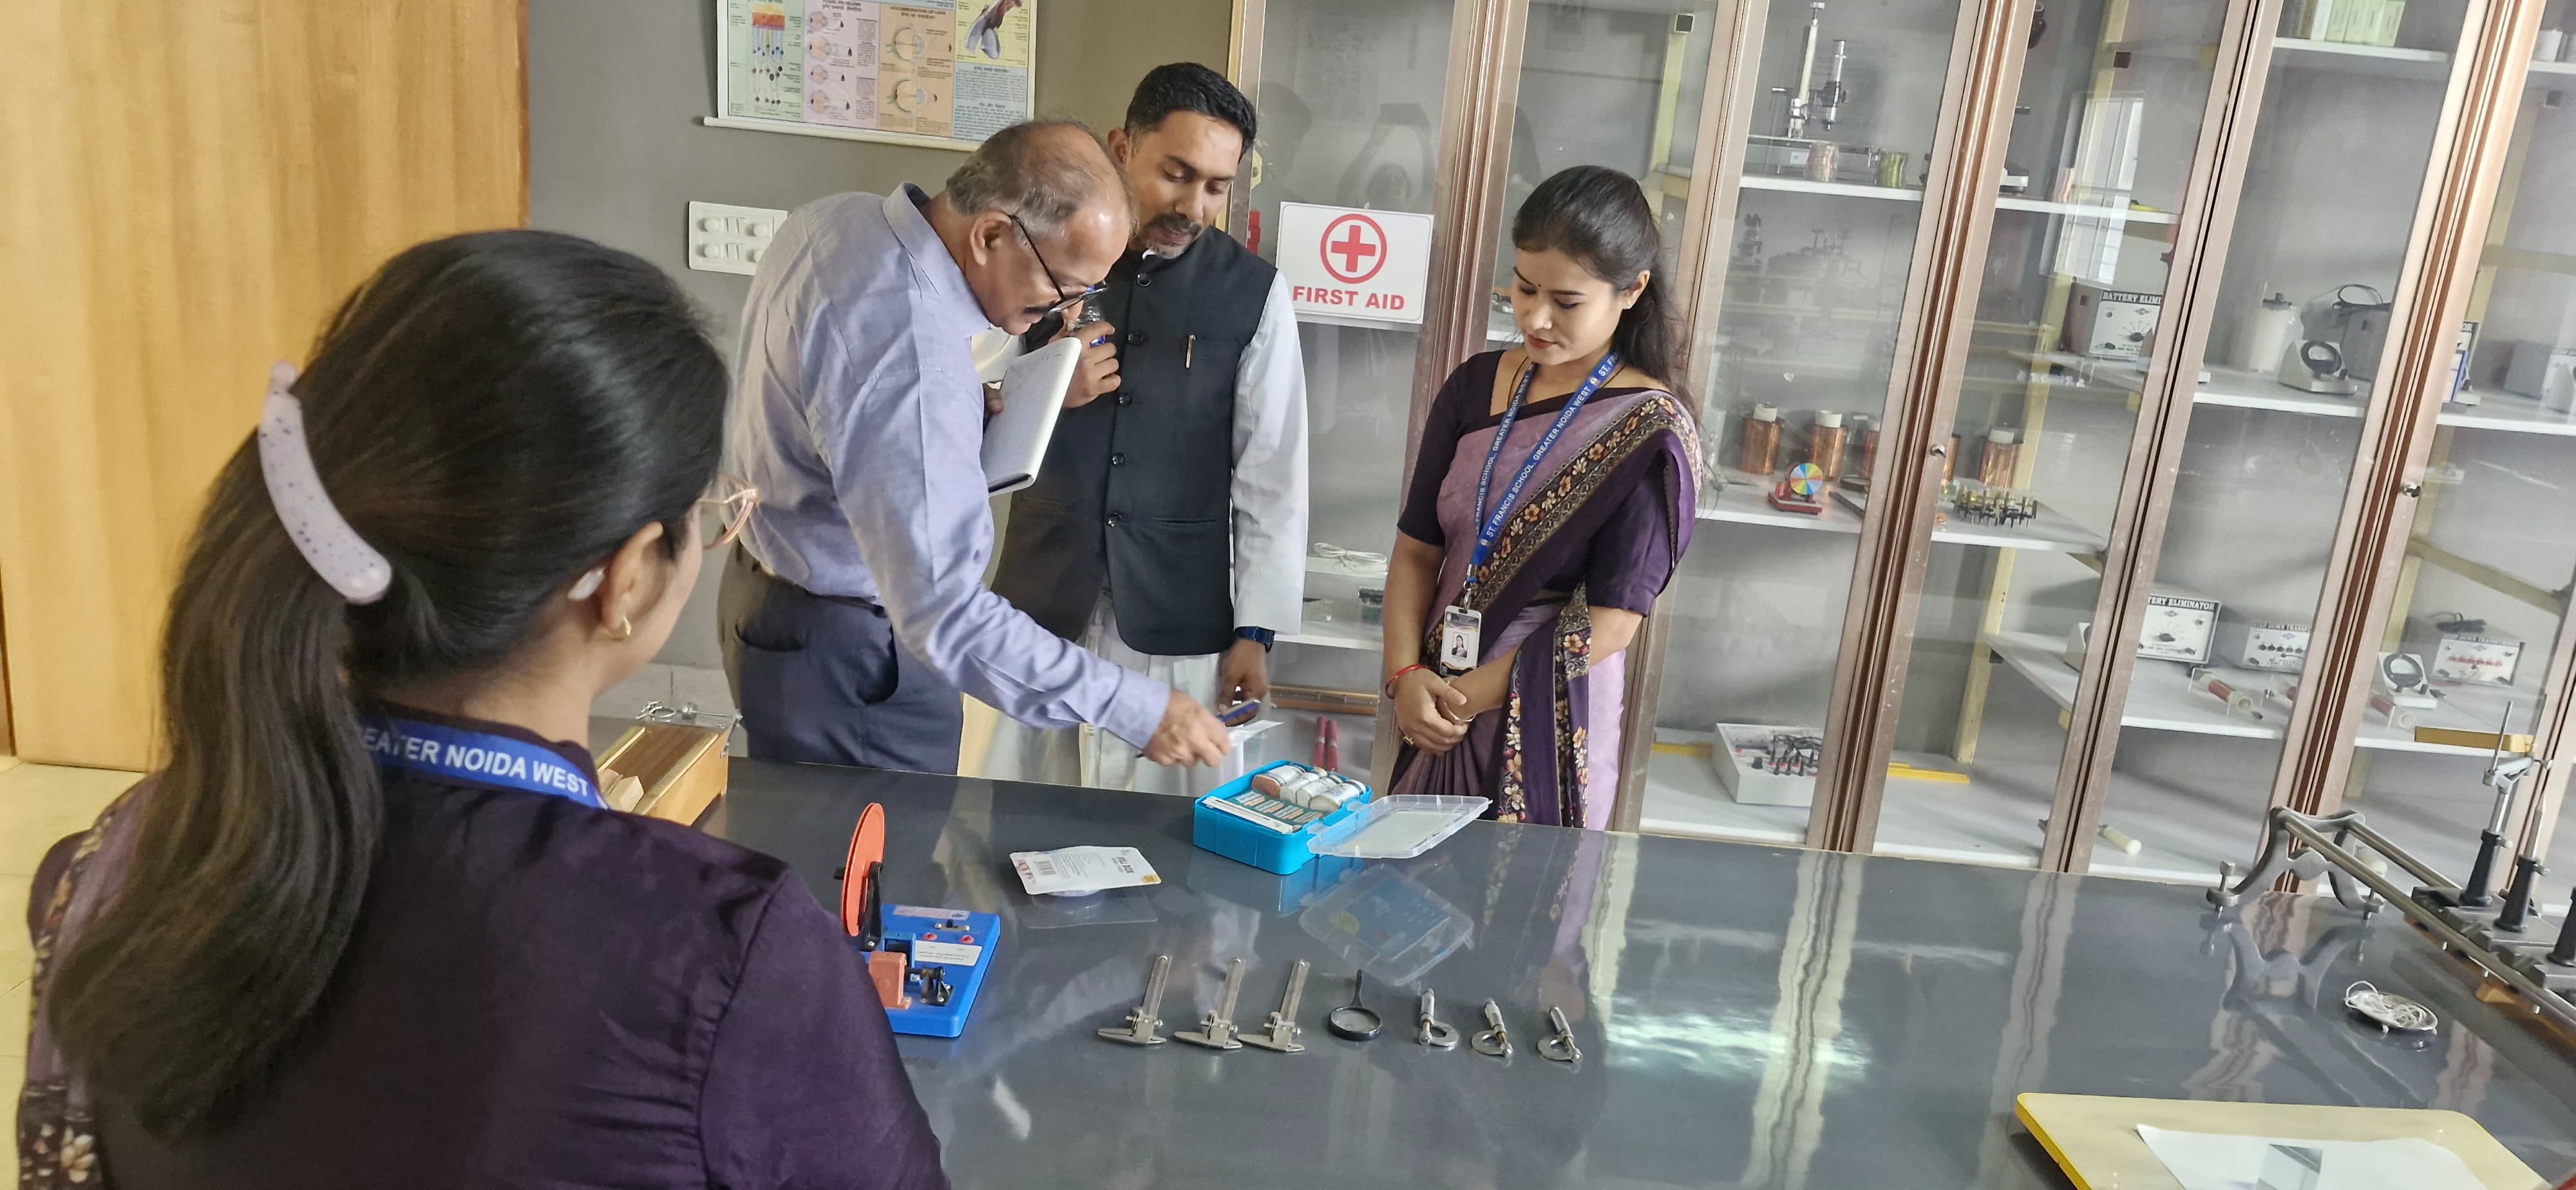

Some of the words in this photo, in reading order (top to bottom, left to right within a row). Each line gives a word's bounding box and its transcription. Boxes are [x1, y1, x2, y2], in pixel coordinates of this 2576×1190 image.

[1293, 286, 1358, 307] FIRST
[1365, 292, 1405, 310] AID
[2103, 291, 2139, 303] BATTERY
[1598, 364, 1611, 377] ST.
[1492, 418, 1512, 451] GREATER
[1506, 395, 1520, 417] NOIDA
[1486, 526, 1497, 538] ST.
[1493, 493, 1515, 525] FRANCIS
[1511, 462, 1537, 493] SCHOOL,
[1533, 428, 1560, 460] GREATER
[1556, 406, 1577, 429] NOIDA
[1572, 386, 1591, 407] WEST
[2168, 599, 2215, 610] ELIMINATOR
[444, 744, 527, 780] NOIDA
[532, 760, 589, 798] WEST
